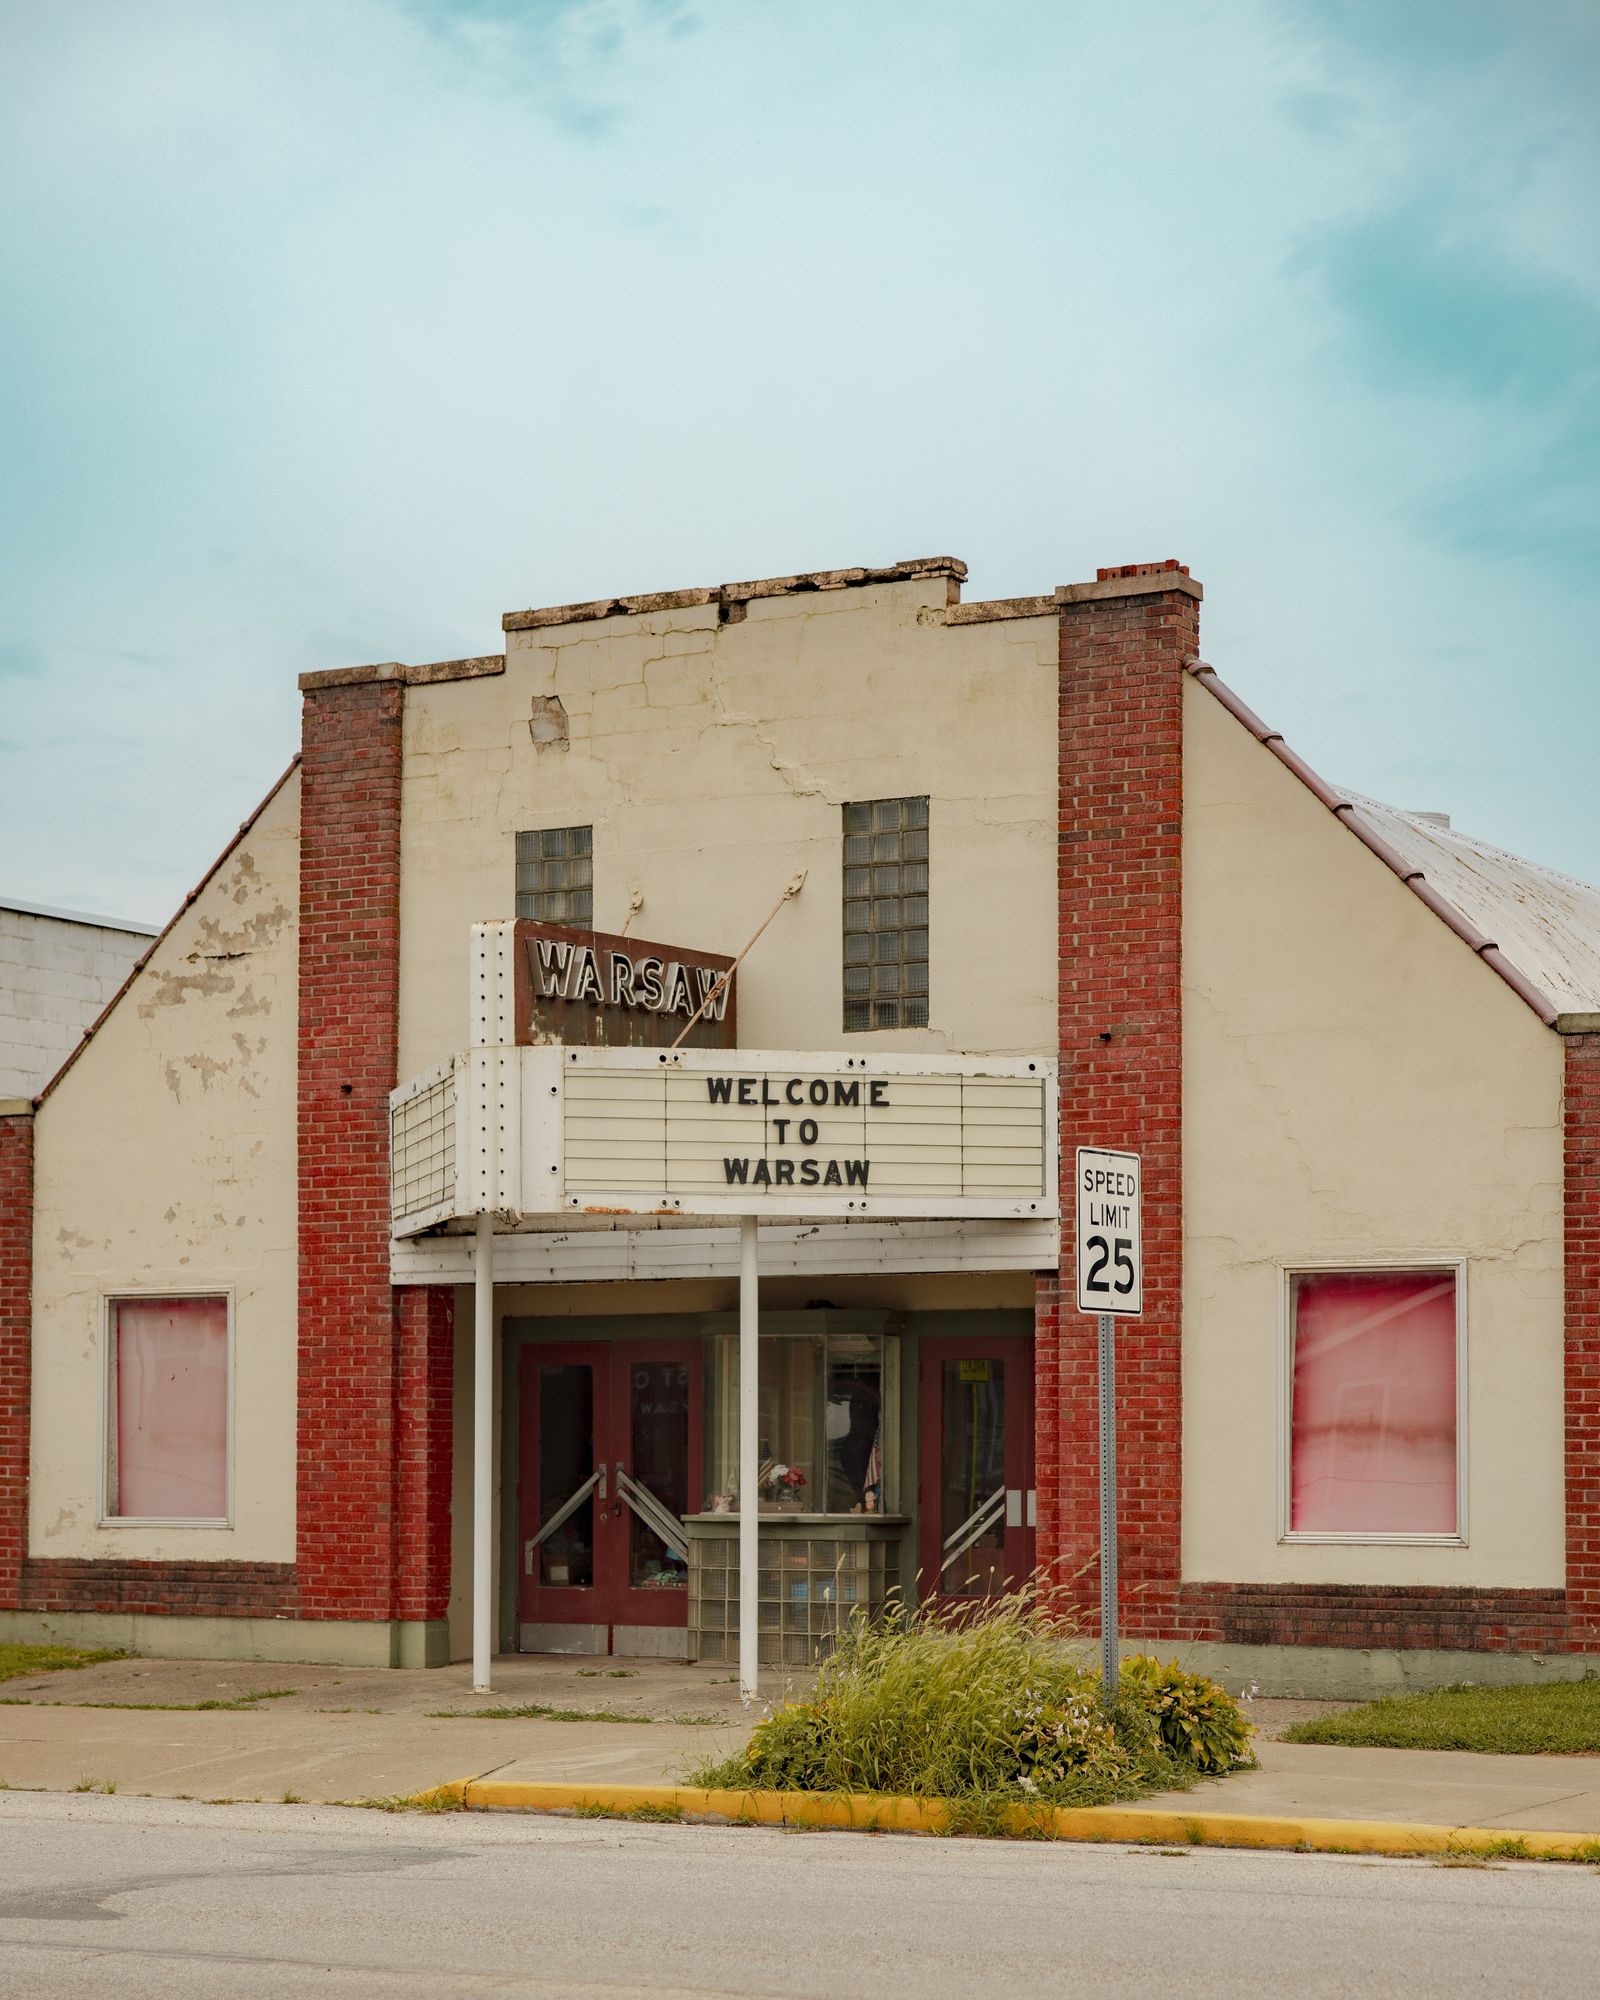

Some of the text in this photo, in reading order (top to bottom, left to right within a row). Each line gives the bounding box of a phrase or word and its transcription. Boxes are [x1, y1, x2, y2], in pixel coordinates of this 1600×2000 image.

[526, 937, 731, 1022] WARSAW
[706, 1077, 890, 1107] WELCOME
[773, 1118, 819, 1146] TO
[723, 1157, 870, 1187] WARSAW
[1084, 1168, 1136, 1197] SPEED
[1089, 1202, 1130, 1229] LIMIT
[1086, 1235, 1135, 1295] 25
